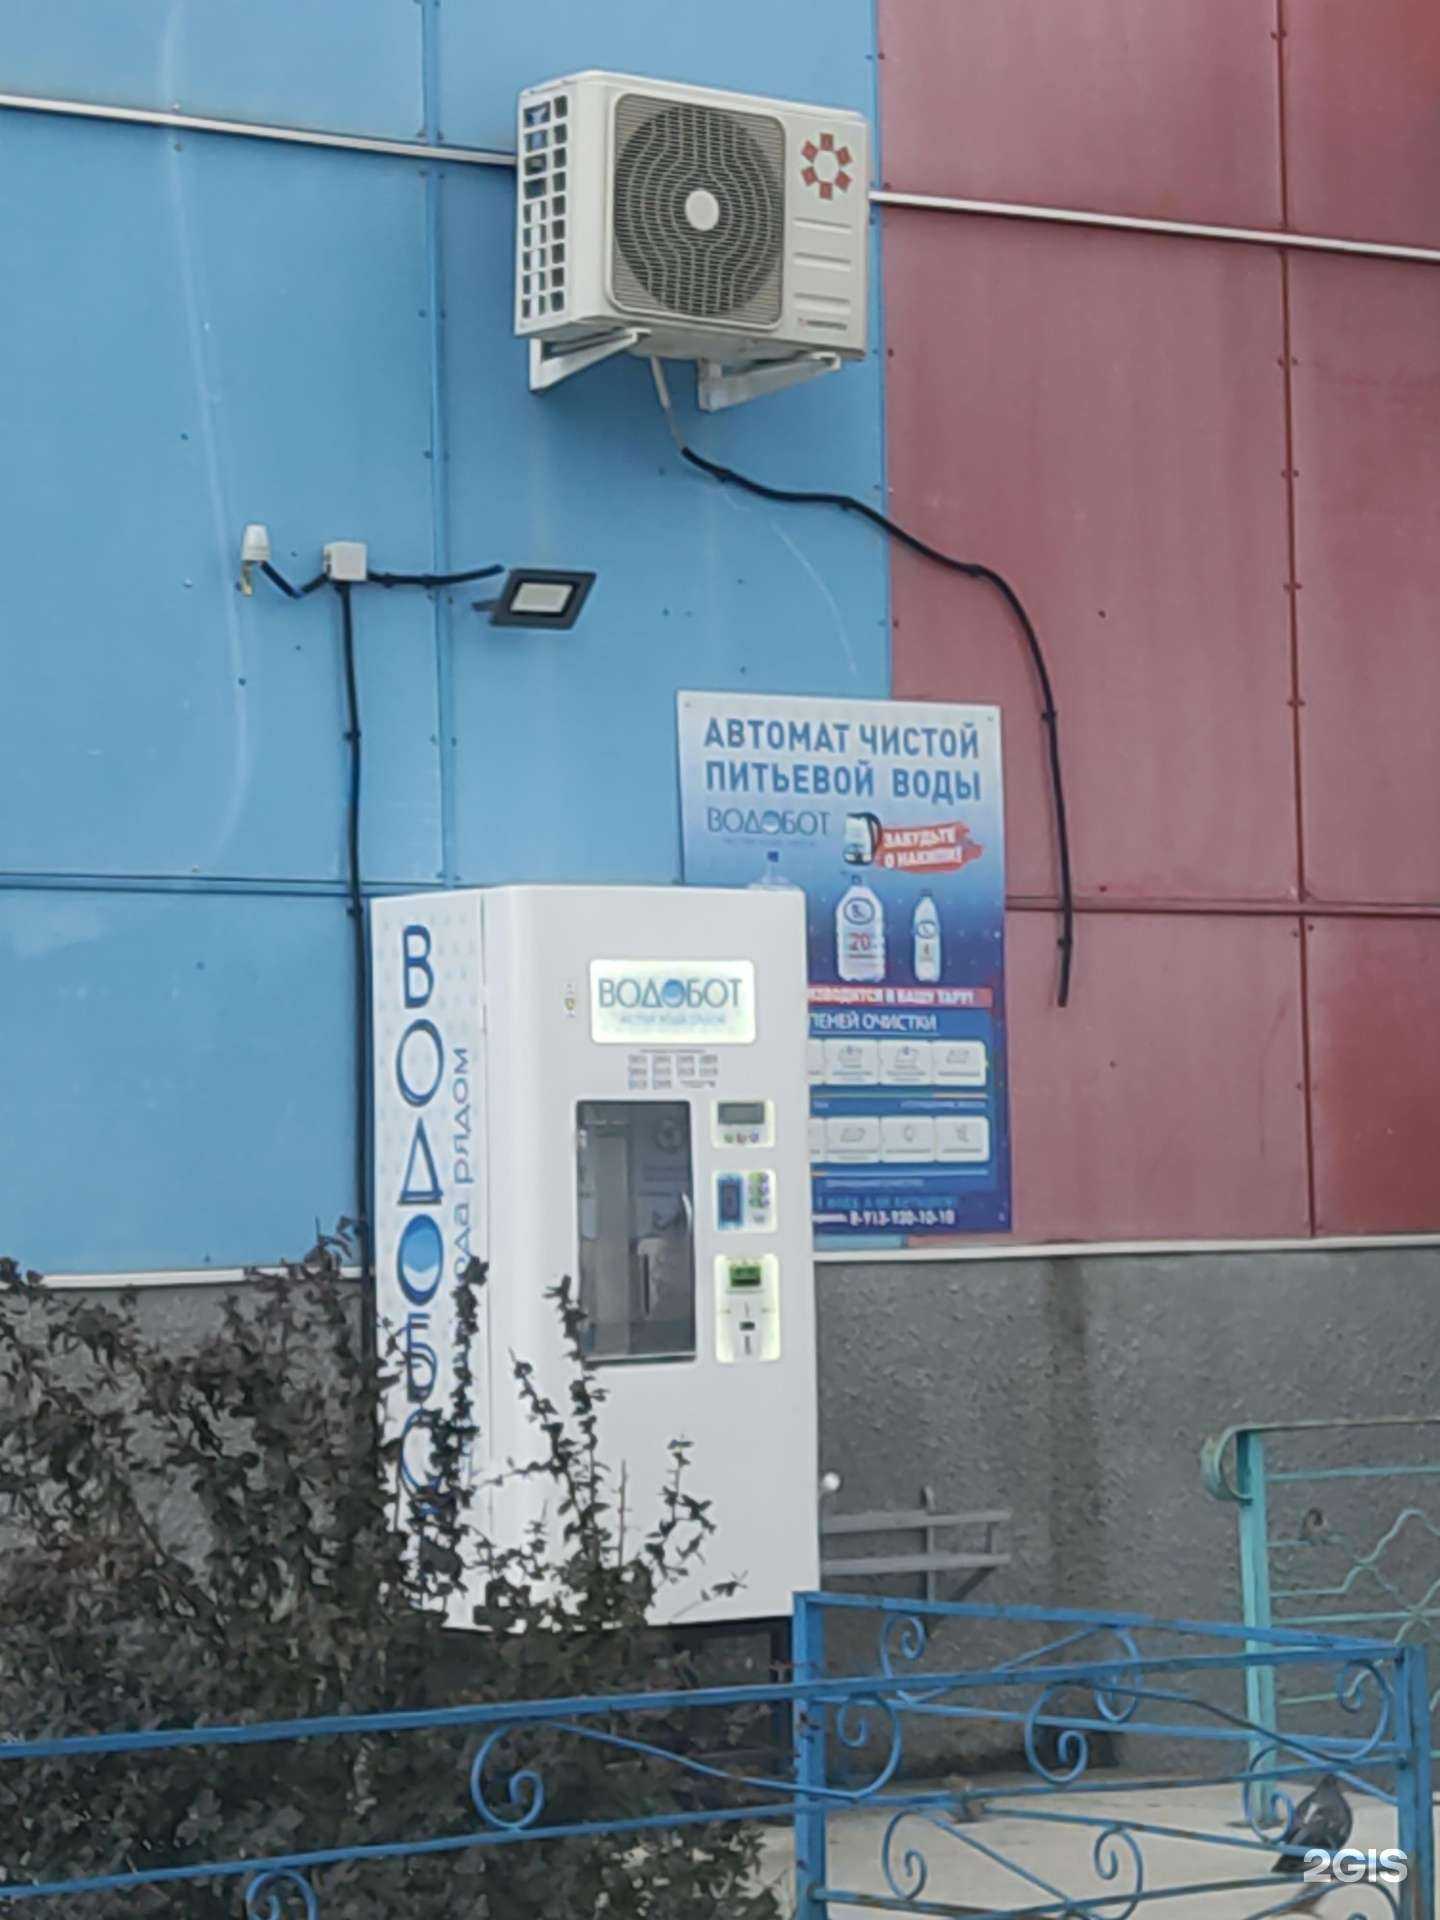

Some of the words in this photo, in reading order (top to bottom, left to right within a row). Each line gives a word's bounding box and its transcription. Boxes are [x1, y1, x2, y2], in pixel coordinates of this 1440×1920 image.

[704, 717, 849, 754] АВТОМАТ
[860, 722, 980, 759] ЧИСТОЙ
[706, 760, 874, 797] ПИТЬЕВОЙ
[892, 768, 981, 805] ВОДЫ
[707, 806, 831, 836] ВОДОБОТ
[598, 977, 743, 1008] ВОДОБОТ
[862, 1013, 937, 1031] ОЧИСТКИ
[452, 1048, 474, 1184] рядом
[395, 924, 445, 1525] ВОДОБО
